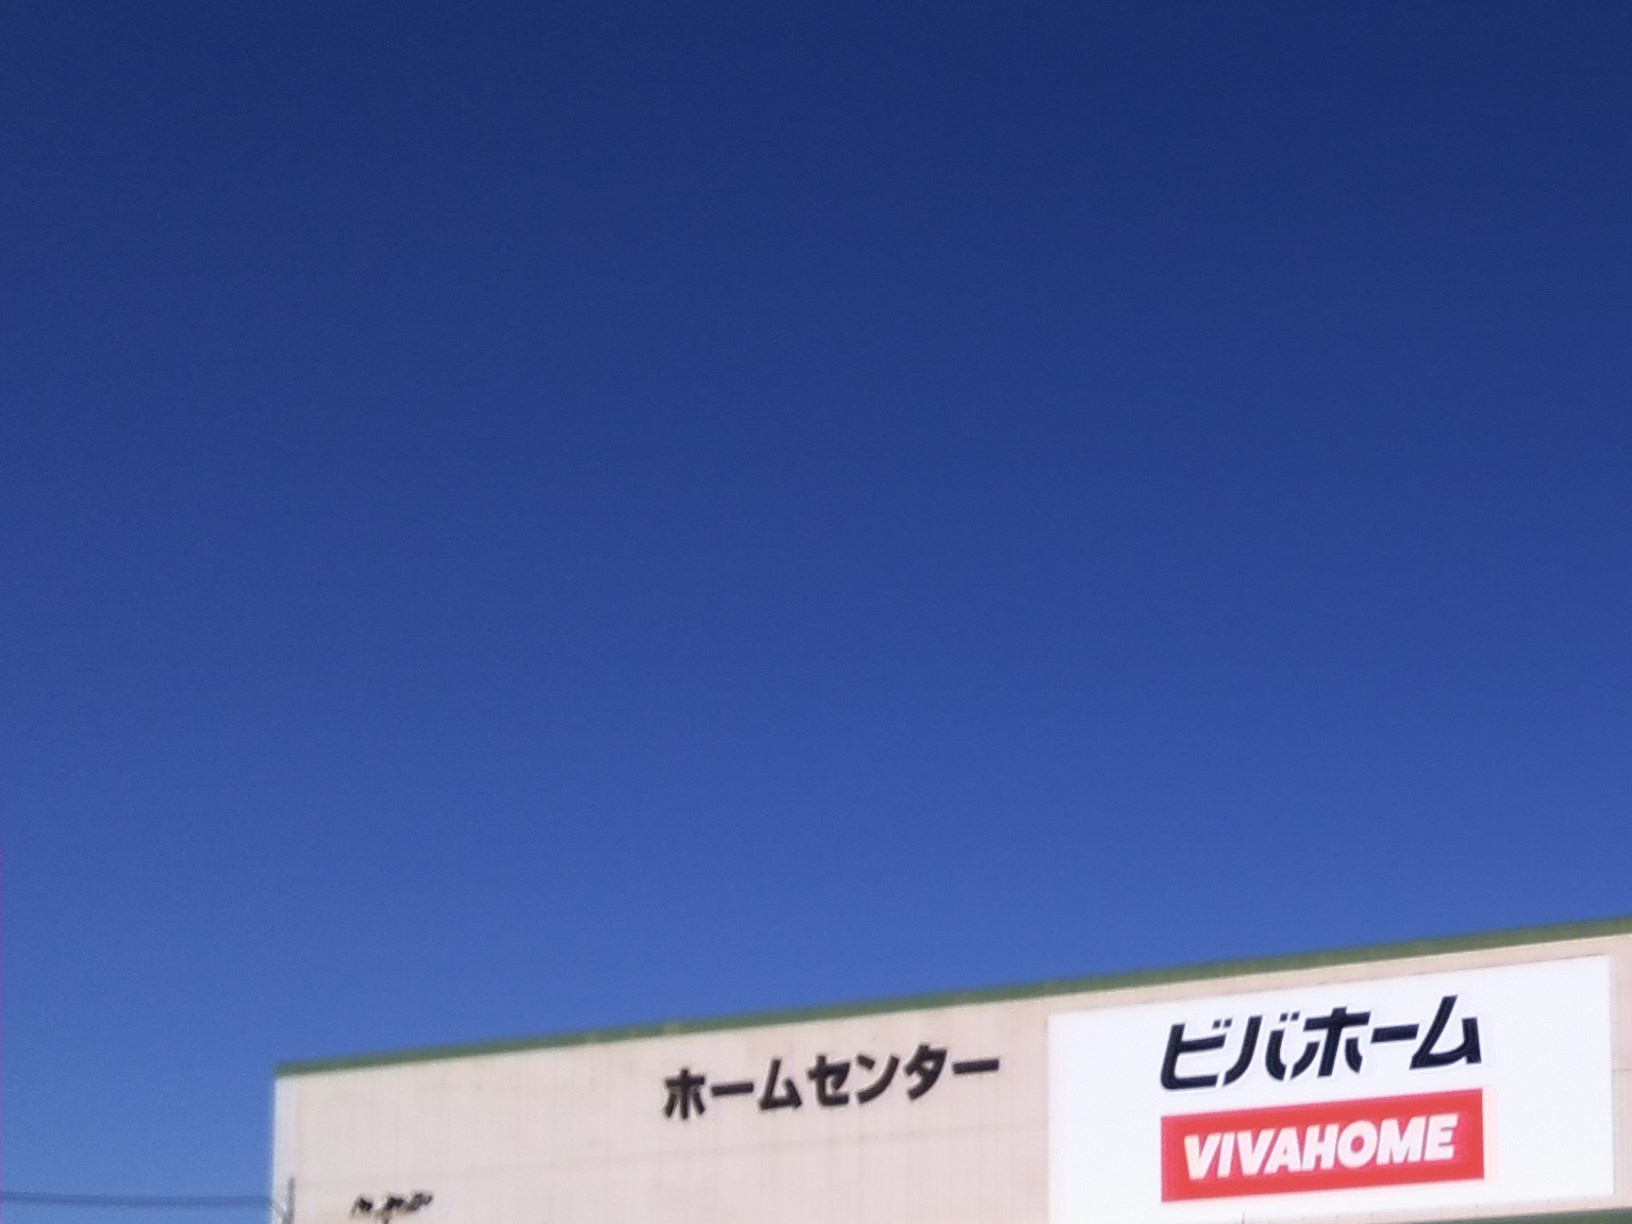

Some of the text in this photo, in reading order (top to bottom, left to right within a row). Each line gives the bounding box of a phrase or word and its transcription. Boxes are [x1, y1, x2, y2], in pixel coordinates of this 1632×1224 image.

[664, 1042, 999, 1120] ホームセンター
[1160, 994, 1482, 1090] ビバホーム
[1183, 1112, 1459, 1182] VIVAHOME
